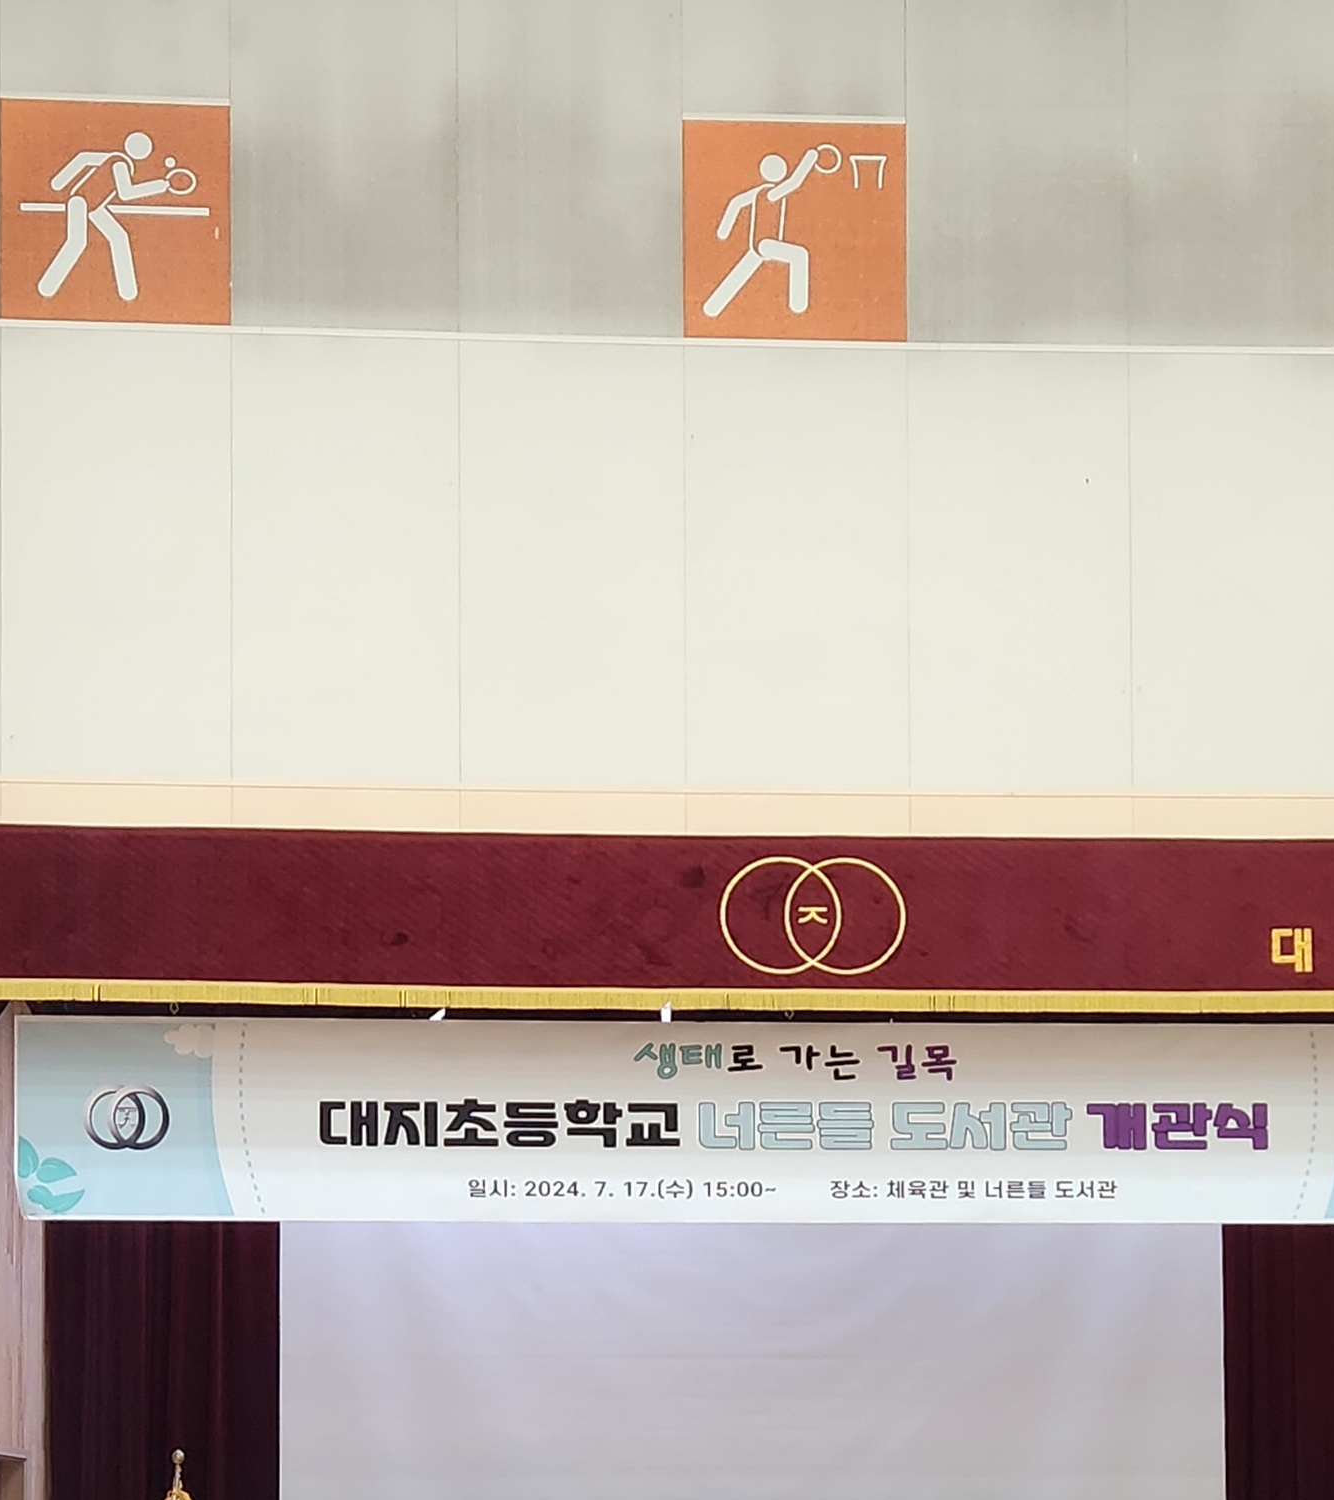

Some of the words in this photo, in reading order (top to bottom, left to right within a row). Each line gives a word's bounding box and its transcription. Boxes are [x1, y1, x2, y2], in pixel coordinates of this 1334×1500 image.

[633, 1042, 764, 1080] 생태로
[779, 1043, 861, 1081] 가는
[876, 1043, 957, 1082] 길목
[319, 1098, 681, 1148] 대지초등학교
[698, 1101, 874, 1151] 너른들
[890, 1101, 1072, 1151] 도서관
[1086, 1101, 1269, 1151] 개관식
[467, 1178, 517, 1199] 일시:
[524, 1180, 587, 1198] 2024.
[594, 1180, 615, 1198] 7.
[622, 1178, 694, 1200] 17.(수)
[702, 1180, 777, 1198] 15:00~
[829, 1178, 879, 1200] 장소:
[886, 1179, 950, 1200] 체육관
[956, 1179, 977, 1200] 및
[984, 1179, 1047, 1200] 너른들
[1054, 1179, 1119, 1200] 도서관
